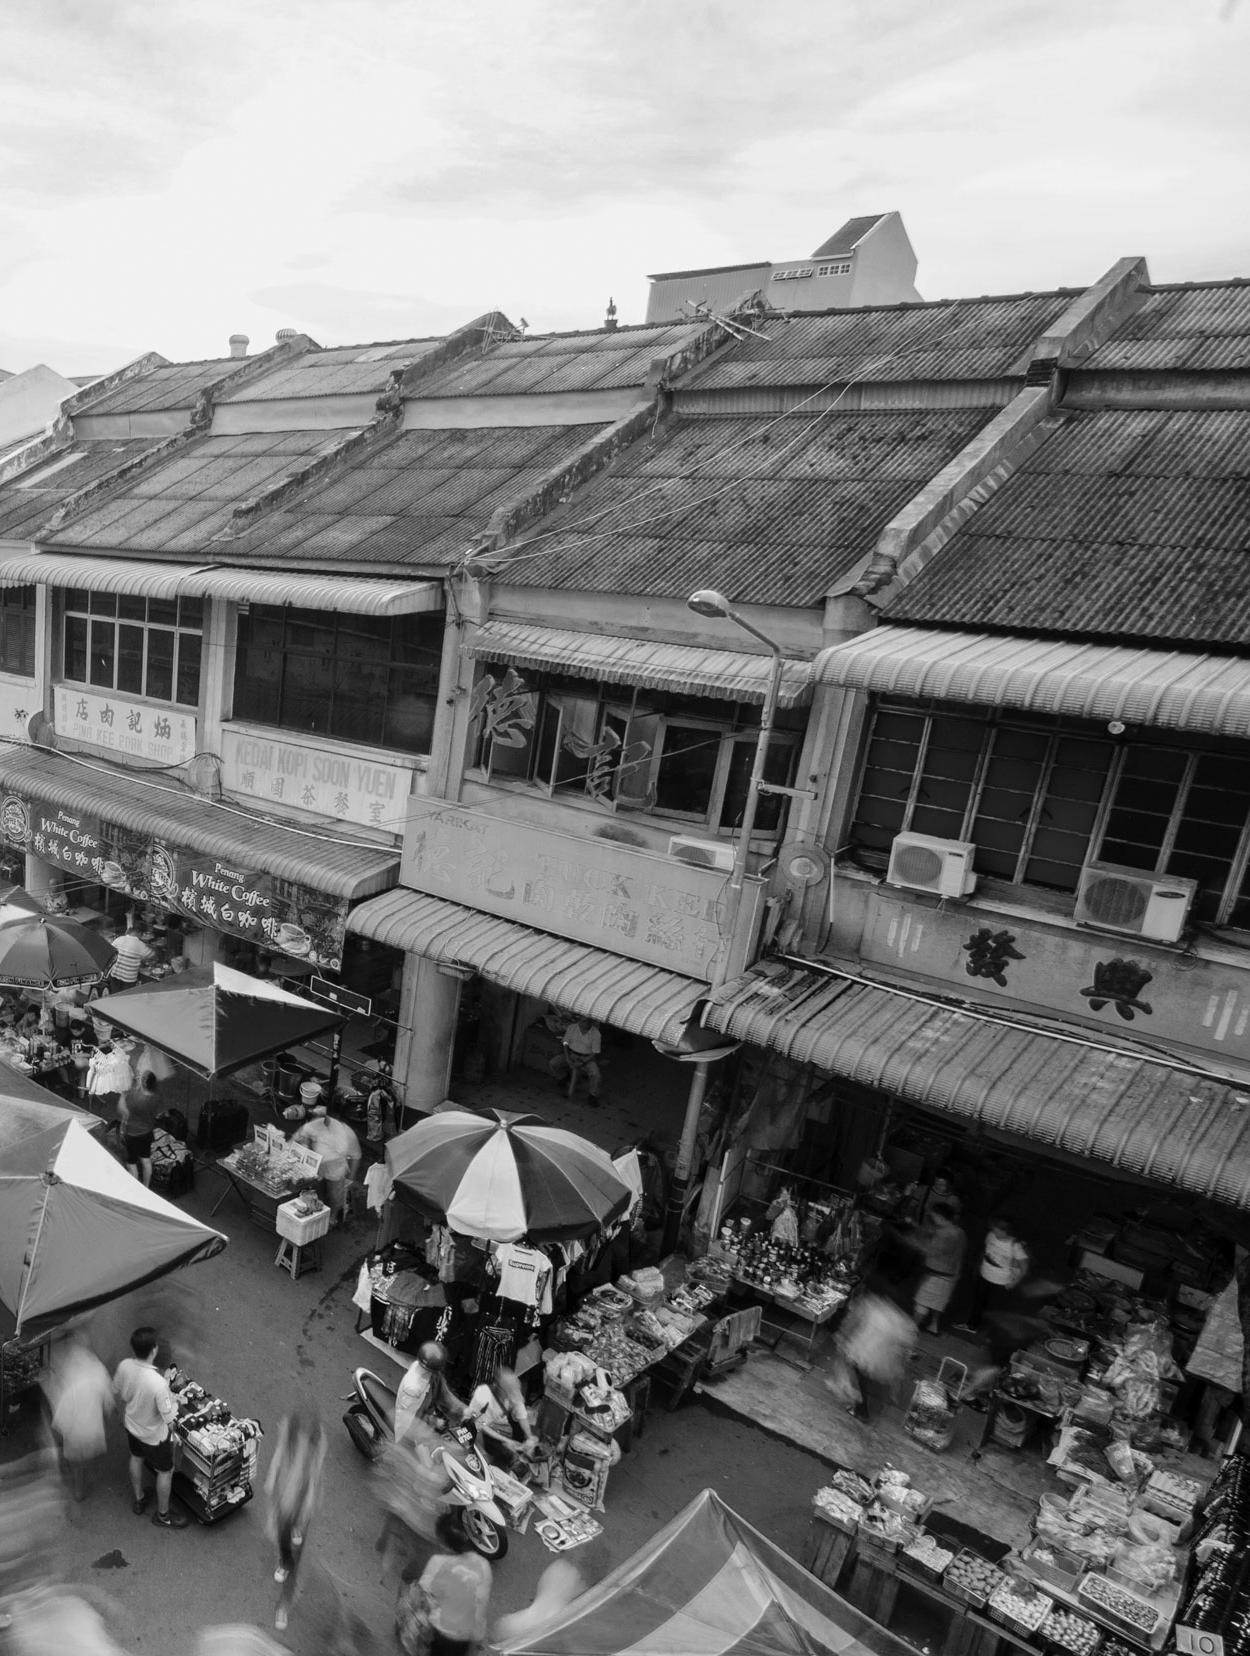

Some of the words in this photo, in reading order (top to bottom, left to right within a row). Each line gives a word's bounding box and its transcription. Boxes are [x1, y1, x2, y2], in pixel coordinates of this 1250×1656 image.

[97, 728, 114, 746] KEE
[236, 738, 273, 771] KEDAI
[278, 748, 308, 779] KOPI
[313, 756, 350, 789] SOON
[356, 764, 396, 800] YUEN
[58, 810, 80, 828] Penang
[41, 818, 68, 837] White
[70, 830, 98, 849] Coffee
[214, 863, 244, 884] Penang
[537, 853, 634, 899] TUCK
[191, 869, 229, 893] White
[231, 885, 270, 907] Coffee
[510, 1261, 534, 1270] Supreme
[1190, 1634, 1214, 1654] 10
